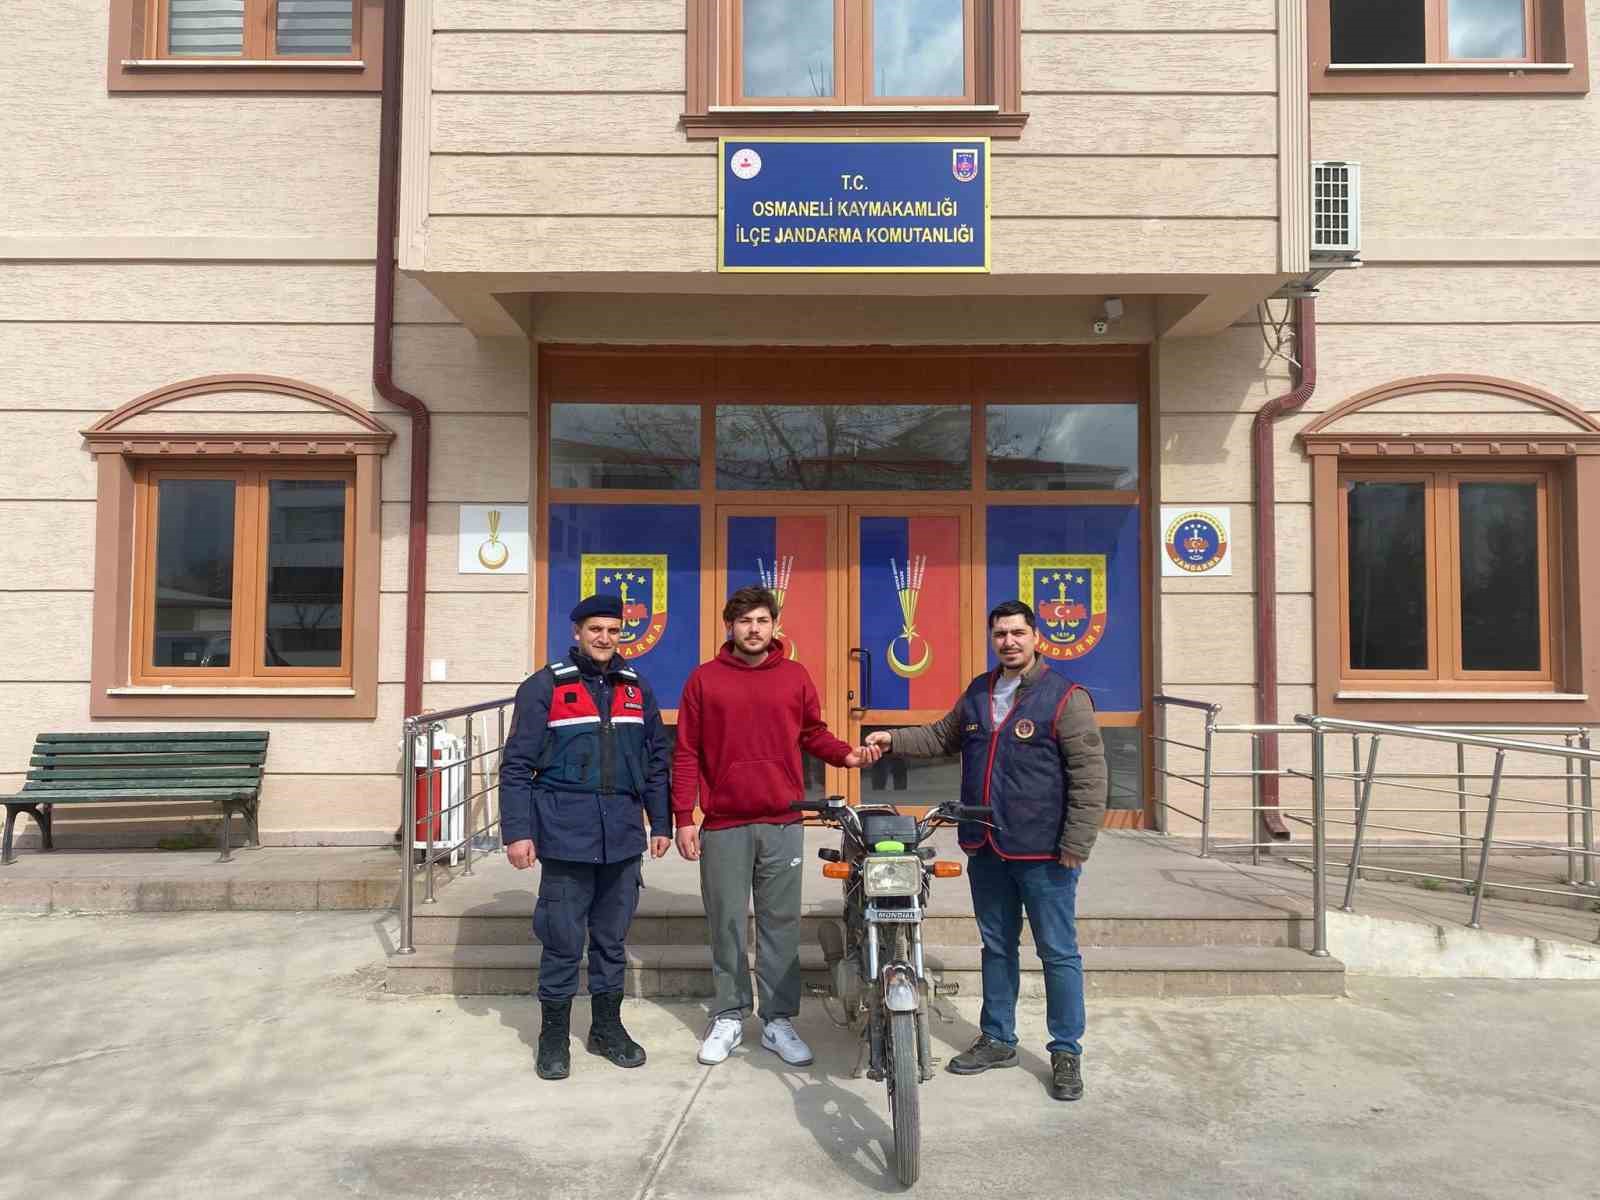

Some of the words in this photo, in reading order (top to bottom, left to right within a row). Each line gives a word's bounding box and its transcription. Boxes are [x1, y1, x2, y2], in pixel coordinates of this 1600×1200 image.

[841, 174, 869, 190] T.C.
[752, 197, 833, 217] OSMANELİ
[838, 197, 957, 217] KAYMAKAMLIĞI
[736, 224, 770, 247] İLÇE
[774, 227, 863, 243] JANDARMA
[866, 223, 975, 243] KOMUTANLIĞI
